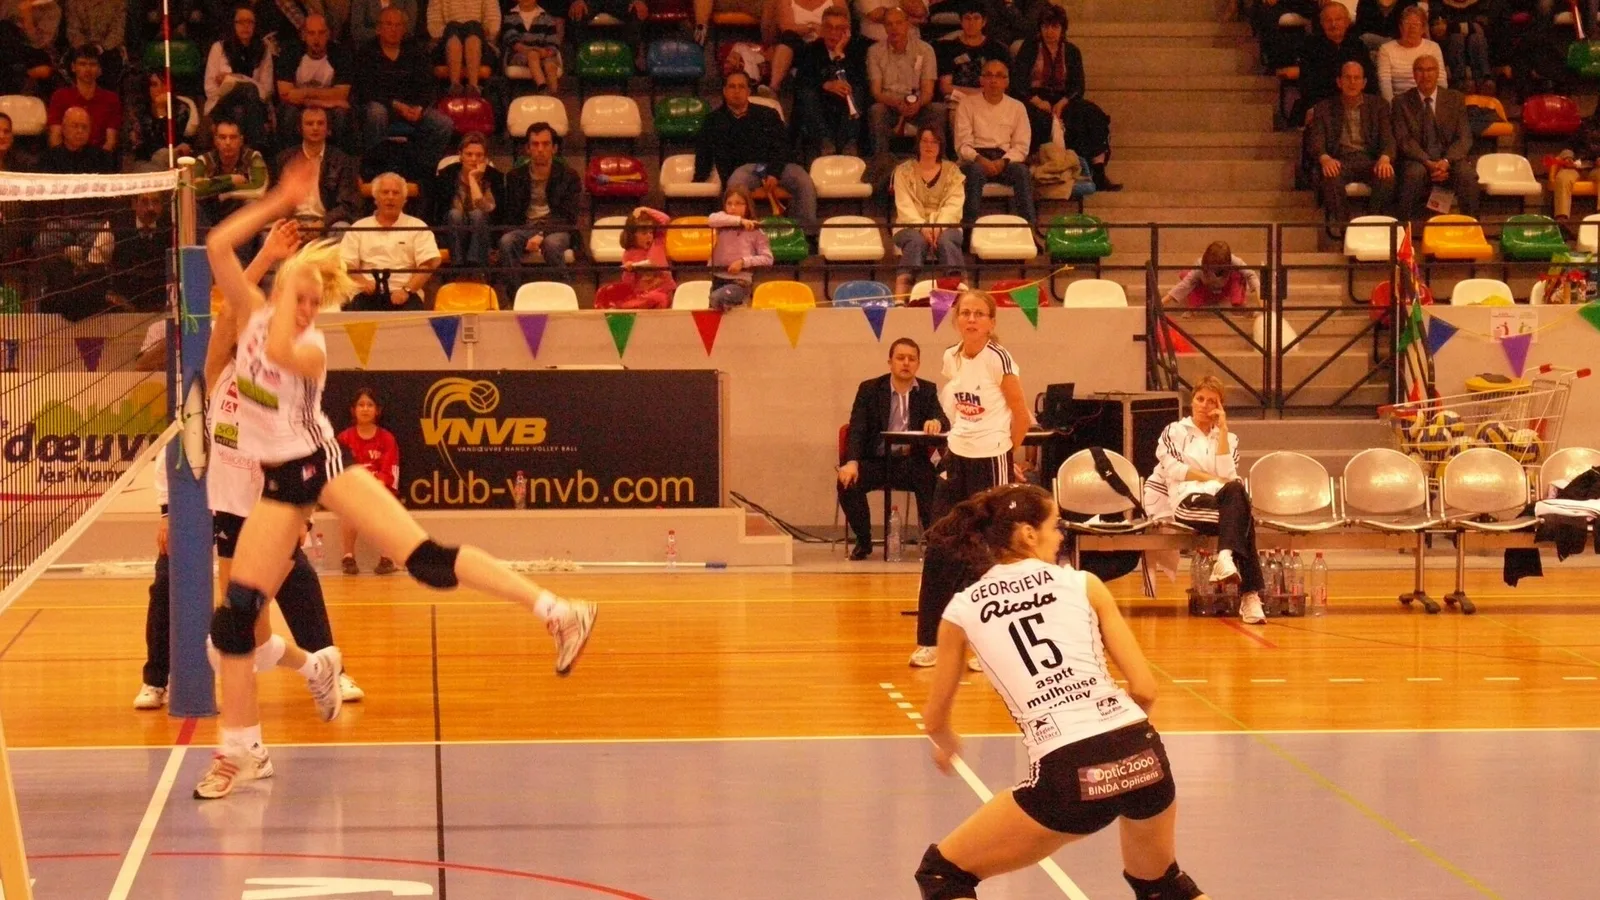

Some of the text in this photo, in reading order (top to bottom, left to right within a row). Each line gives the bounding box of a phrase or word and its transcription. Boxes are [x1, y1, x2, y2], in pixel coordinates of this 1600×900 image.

[953, 391, 981, 406] TEAM
[420, 418, 548, 445] VNVB
[504, 445, 530, 453] NANCY
[533, 445, 559, 453] VOLLEY
[561, 445, 578, 453] BALL
[970, 570, 1055, 603] GEORGIEVA
[980, 592, 1057, 623] Ricola
[1008, 612, 1064, 677] 15
[1035, 666, 1075, 690] asptt
[1026, 676, 1098, 709] mulhouse
[1087, 770, 1159, 796] BINDA Opticiens
